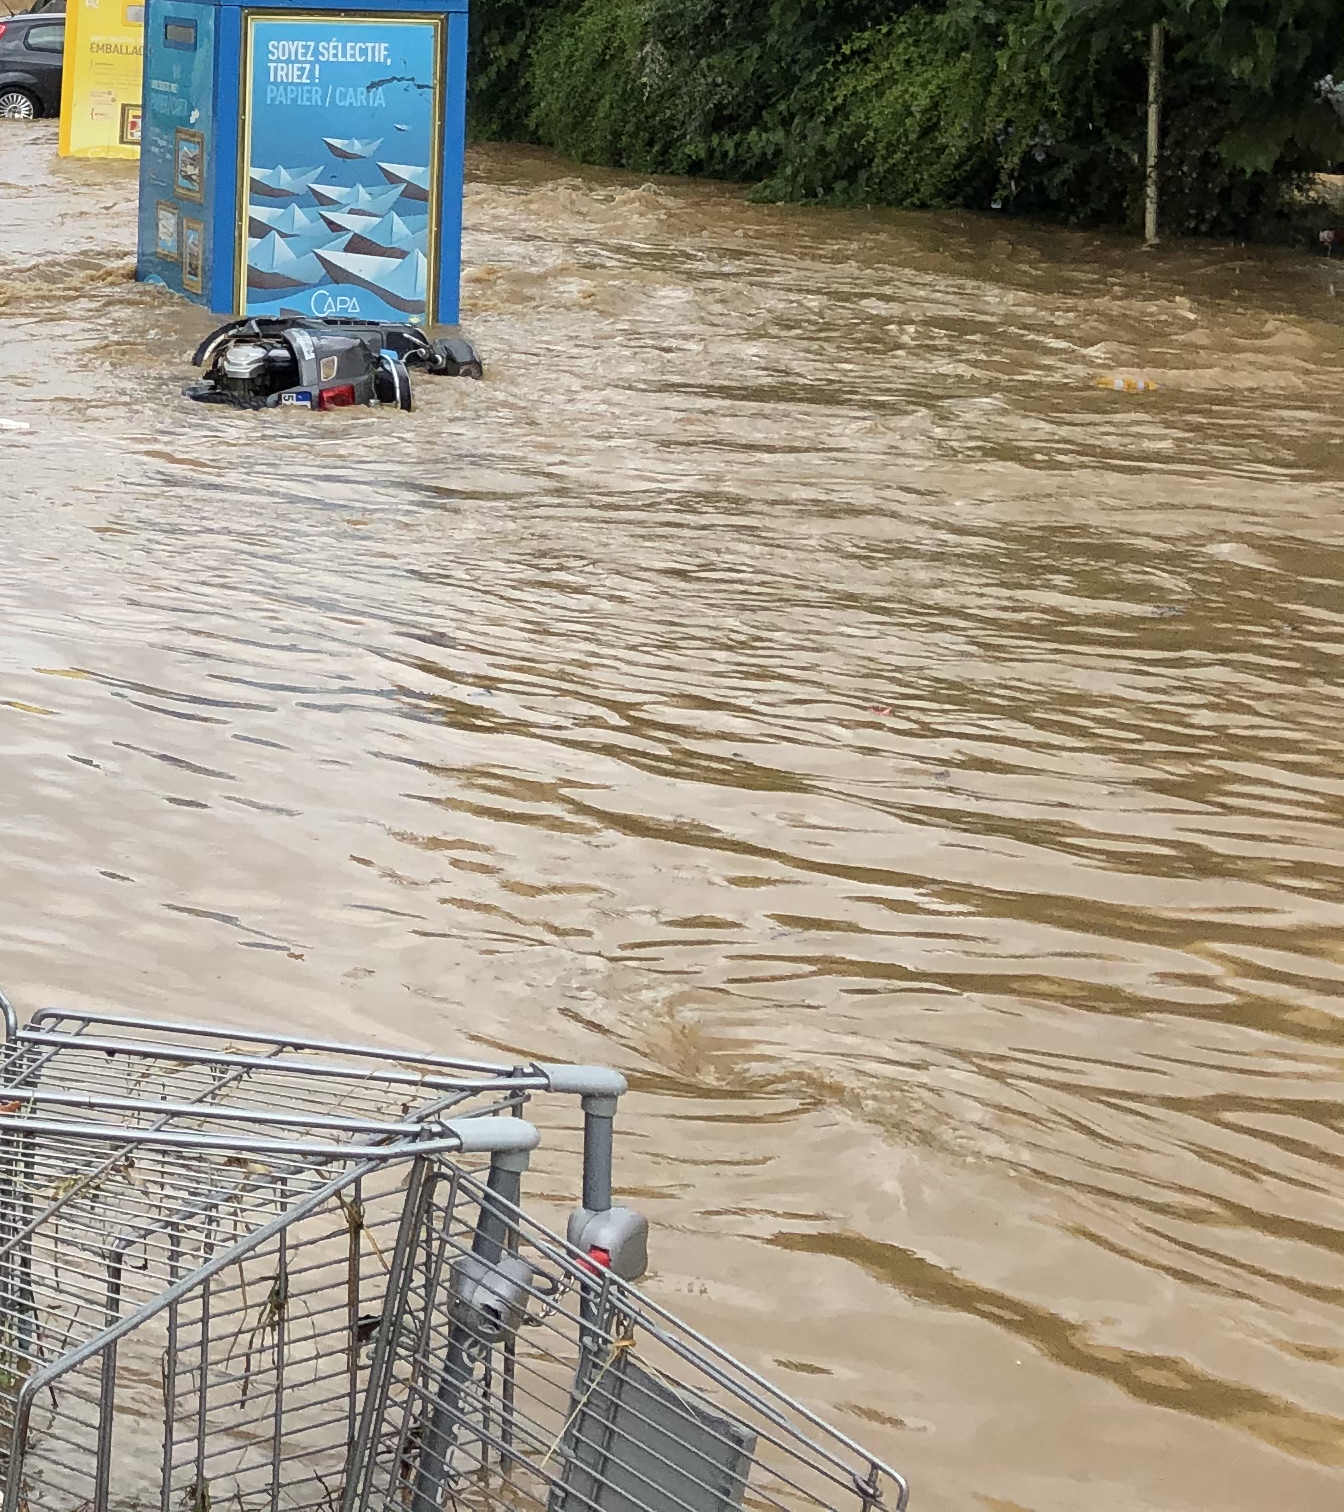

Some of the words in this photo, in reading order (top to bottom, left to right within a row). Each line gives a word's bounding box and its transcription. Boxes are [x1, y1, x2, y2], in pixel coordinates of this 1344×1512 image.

[268, 41, 315, 61] SOYEZ
[318, 37, 392, 66] SÉLECTIF,
[267, 63, 311, 83] TRIEZ
[266, 85, 322, 105] PAPIER
[335, 87, 386, 108] CARTA
[311, 290, 360, 317] CAPA
